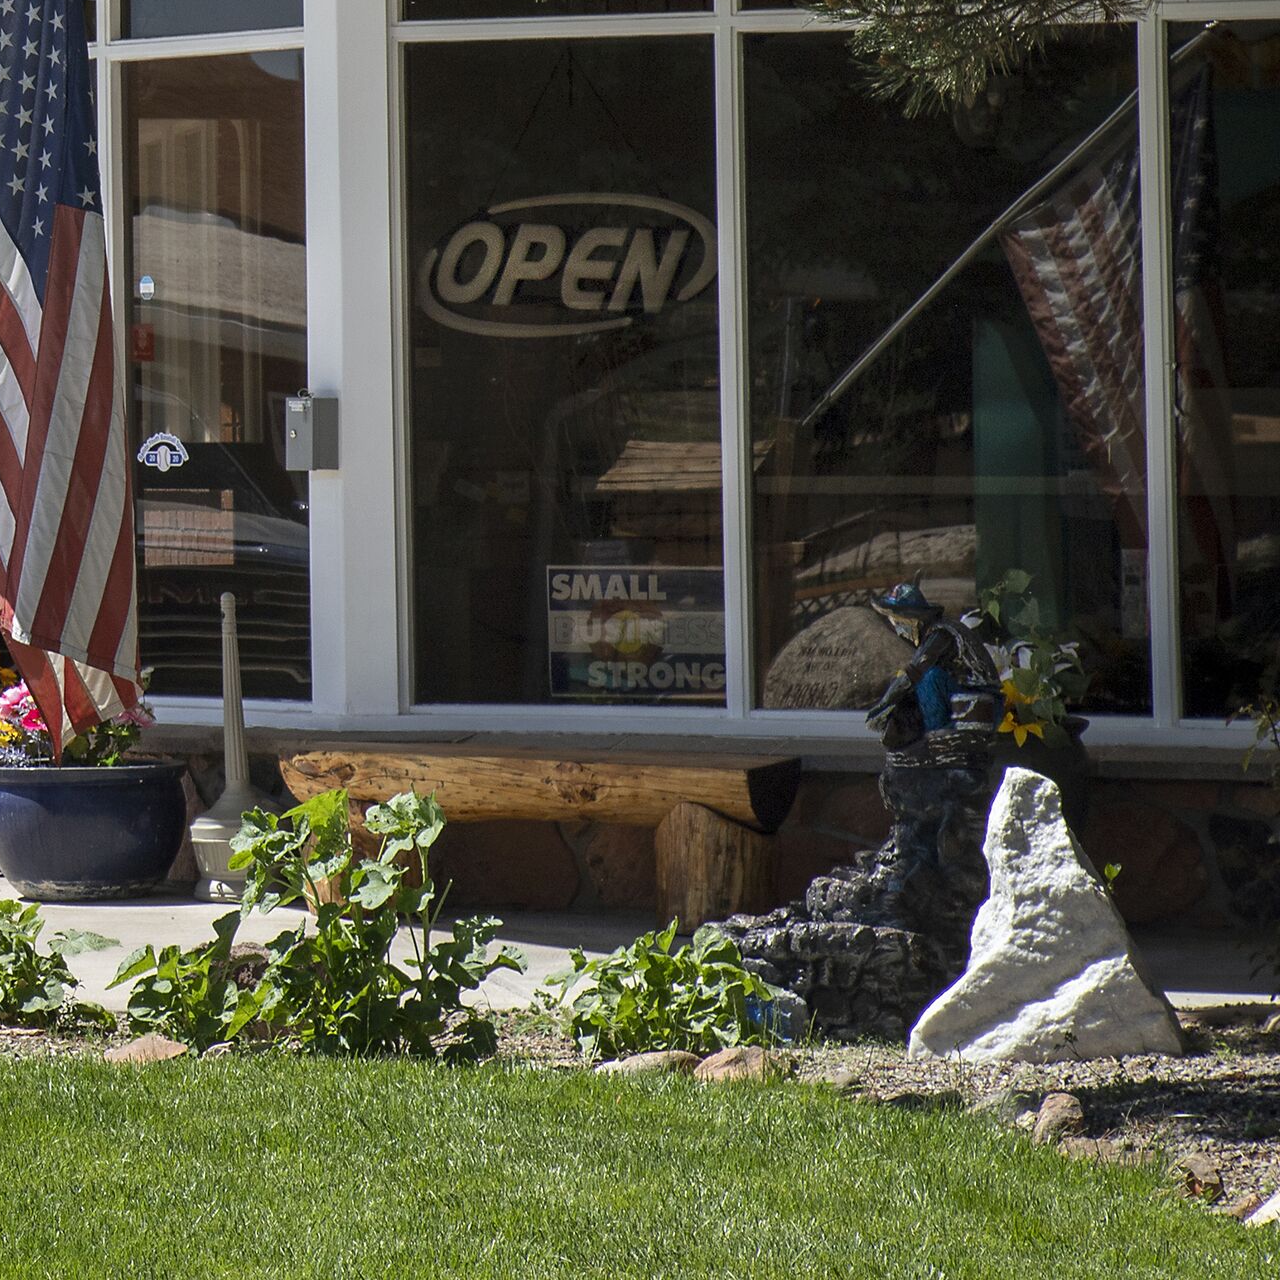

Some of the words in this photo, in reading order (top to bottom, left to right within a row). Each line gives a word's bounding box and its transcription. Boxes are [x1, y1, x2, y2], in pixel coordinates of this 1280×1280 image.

[436, 220, 691, 313] OPEN
[551, 573, 667, 601] SMALL
[555, 616, 725, 646] BUSINESS
[587, 661, 726, 690] STRONG
